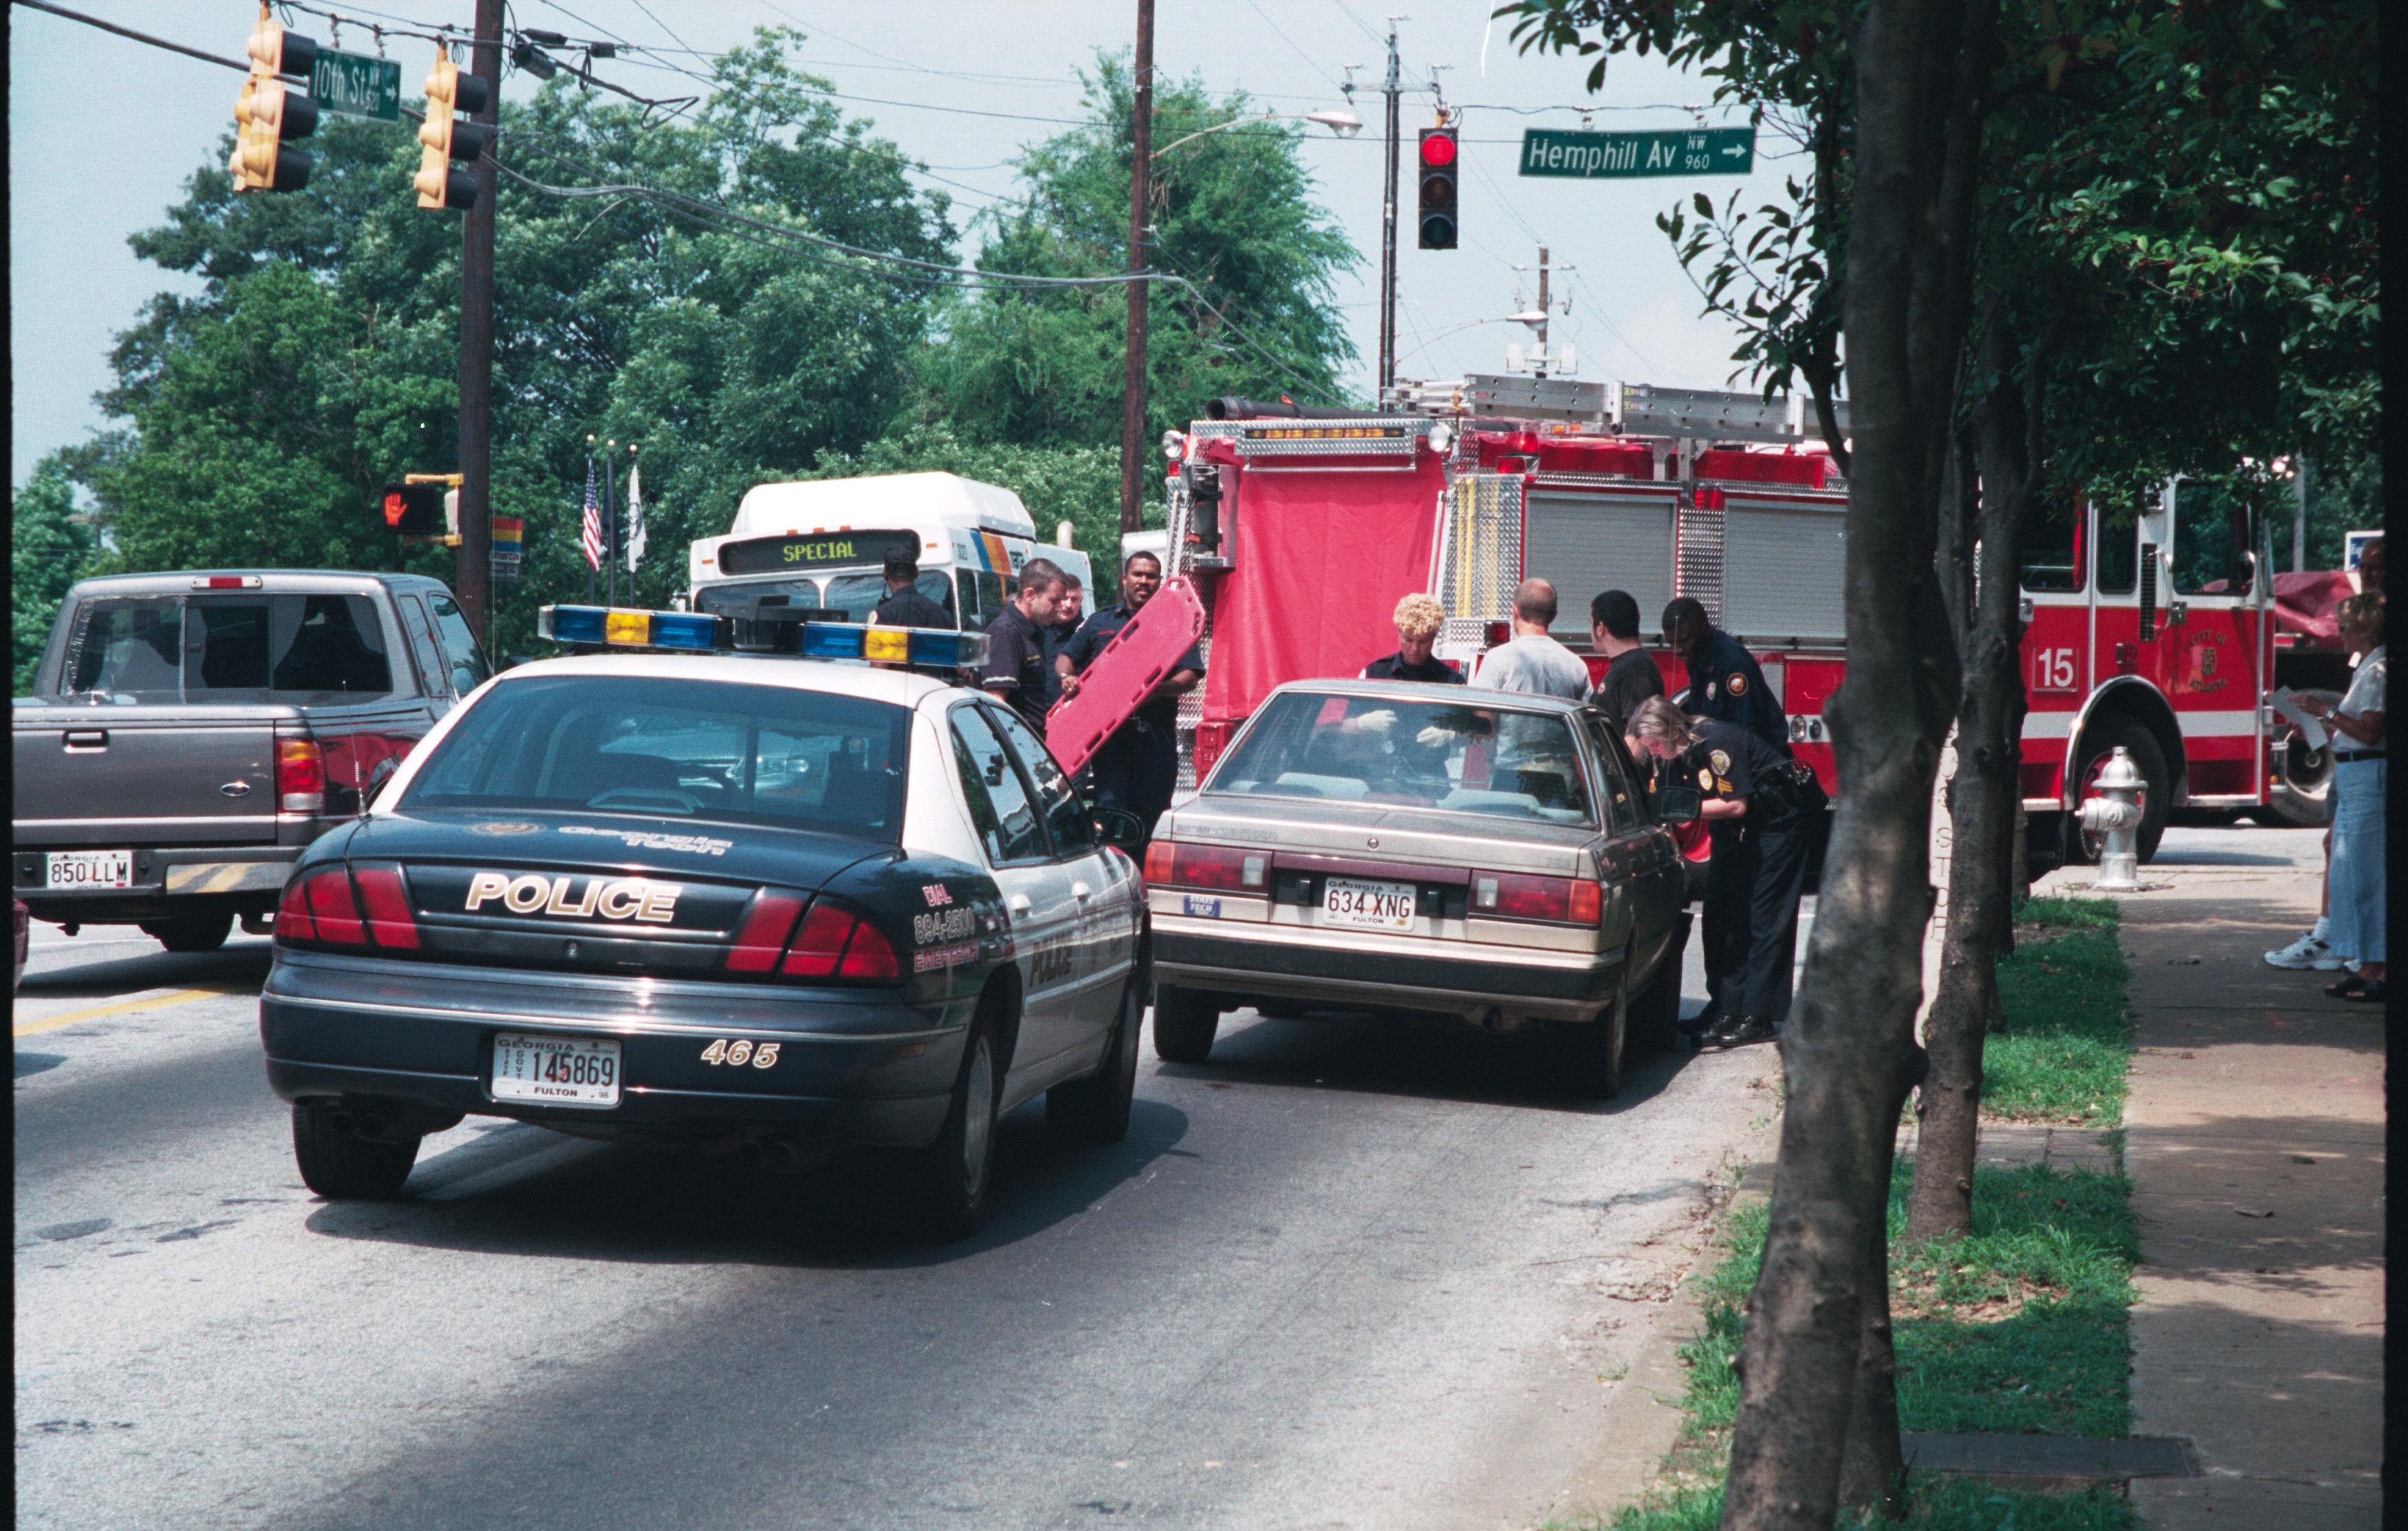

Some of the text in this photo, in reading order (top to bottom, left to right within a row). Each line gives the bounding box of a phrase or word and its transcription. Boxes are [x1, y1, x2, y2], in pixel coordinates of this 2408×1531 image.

[314, 59, 366, 106] 10th St
[1687, 135, 1707, 150] NW
[1528, 138, 1676, 177] Hemphill Av
[1685, 155, 1710, 169] 960
[784, 541, 857, 562] SPECIAL
[2189, 630, 2227, 647] CITY OF
[2039, 648, 2073, 687] 15
[2189, 678, 2228, 693] ATLANTA
[52, 861, 126, 883] 850 LLM
[465, 872, 683, 922] POLICE
[922, 884, 953, 907] DIAL
[1328, 881, 1383, 891] GEORGIA
[1328, 890, 1411, 918] 634 XNG
[913, 907, 975, 944] 894-2500
[498, 1039, 575, 1052] GEORGIA
[700, 1039, 781, 1069] 465
[533, 1051, 614, 1087] 145869
[534, 1086, 578, 1098] FULTON
